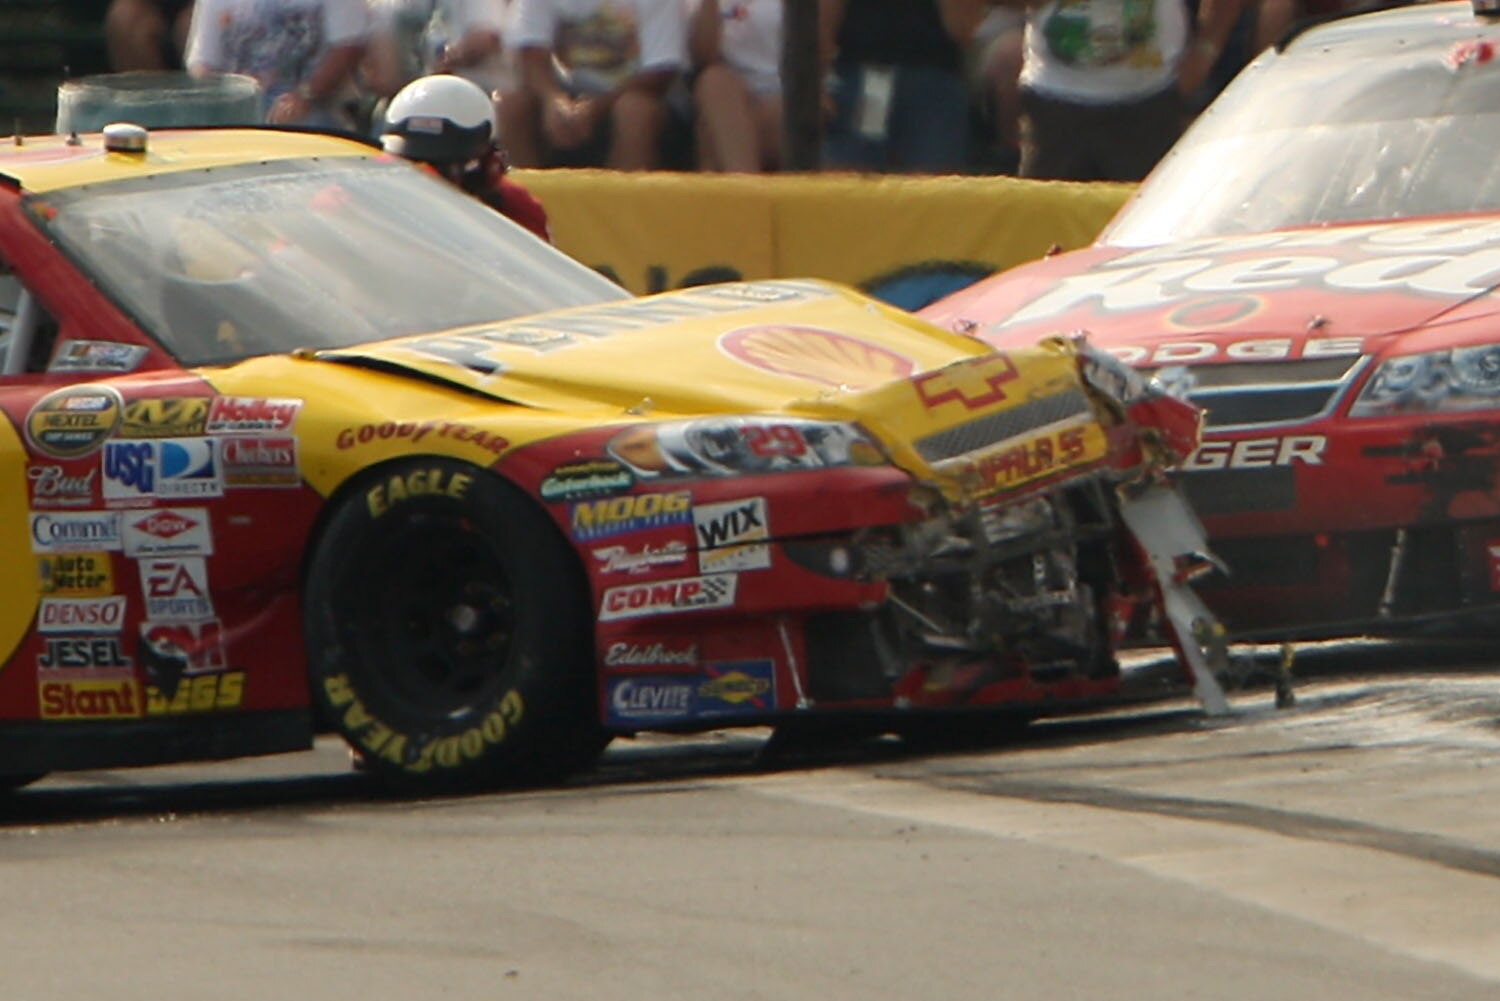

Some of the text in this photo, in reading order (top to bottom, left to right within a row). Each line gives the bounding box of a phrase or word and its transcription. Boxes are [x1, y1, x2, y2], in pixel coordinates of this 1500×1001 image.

[1103, 338, 1365, 363] ODGE
[335, 421, 510, 454] GOODYEAR
[28, 464, 97, 497] Bud
[104, 441, 154, 493] USG
[159, 482, 218, 494] DIRECTV
[366, 468, 475, 519] EAGLE
[574, 490, 692, 529] MOOG
[698, 501, 761, 549] WIX
[147, 562, 202, 597] EA
[43, 602, 120, 625] DENSO
[608, 582, 701, 612] COMP
[39, 639, 128, 668] JESEL
[41, 683, 136, 717] Stant
